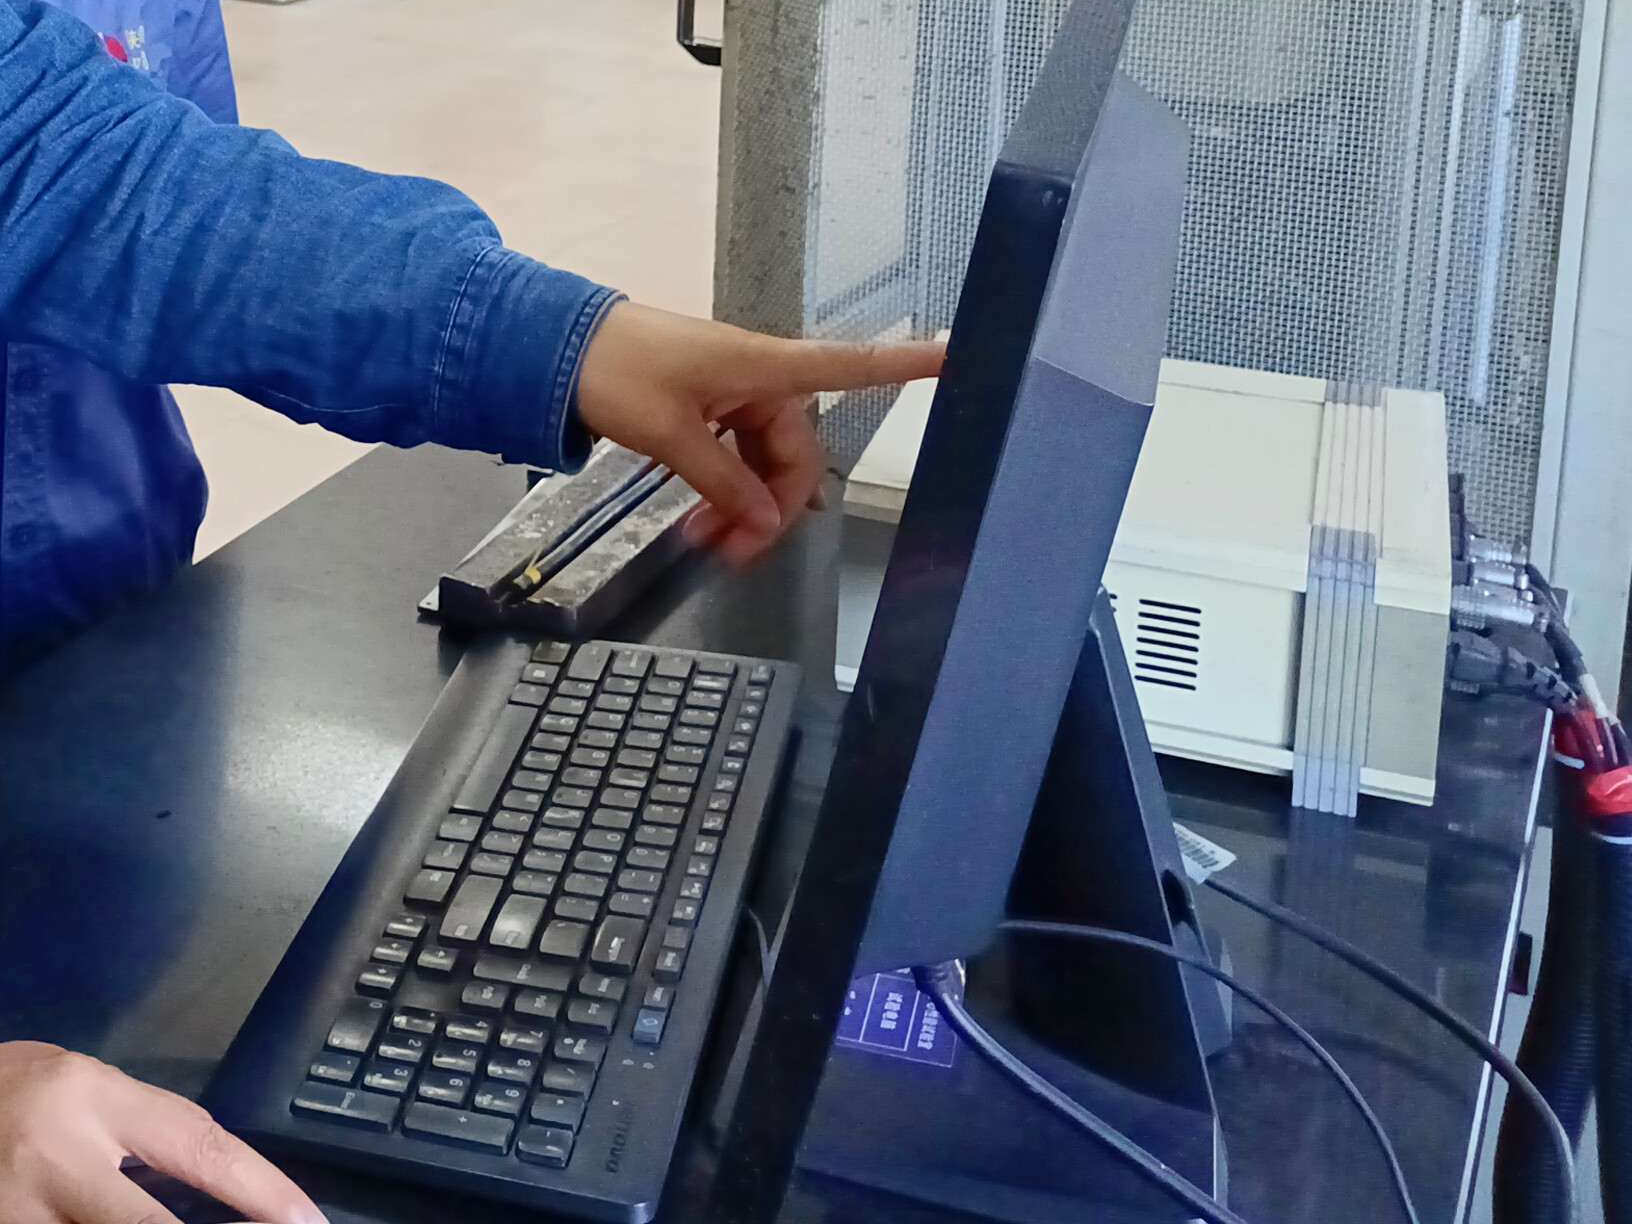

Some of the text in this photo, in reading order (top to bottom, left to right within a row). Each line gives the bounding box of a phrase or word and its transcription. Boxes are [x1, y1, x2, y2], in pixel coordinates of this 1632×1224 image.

[370, 1001, 383, 1009] 0
[475, 1020, 488, 1028] 4
[529, 1030, 544, 1039] 7
[408, 1038, 422, 1047] 2
[463, 1048, 477, 1057] 5
[517, 1058, 531, 1067] 8
[394, 1068, 408, 1076] 3
[449, 1078, 463, 1087] 6
[505, 1089, 519, 1097] 9
